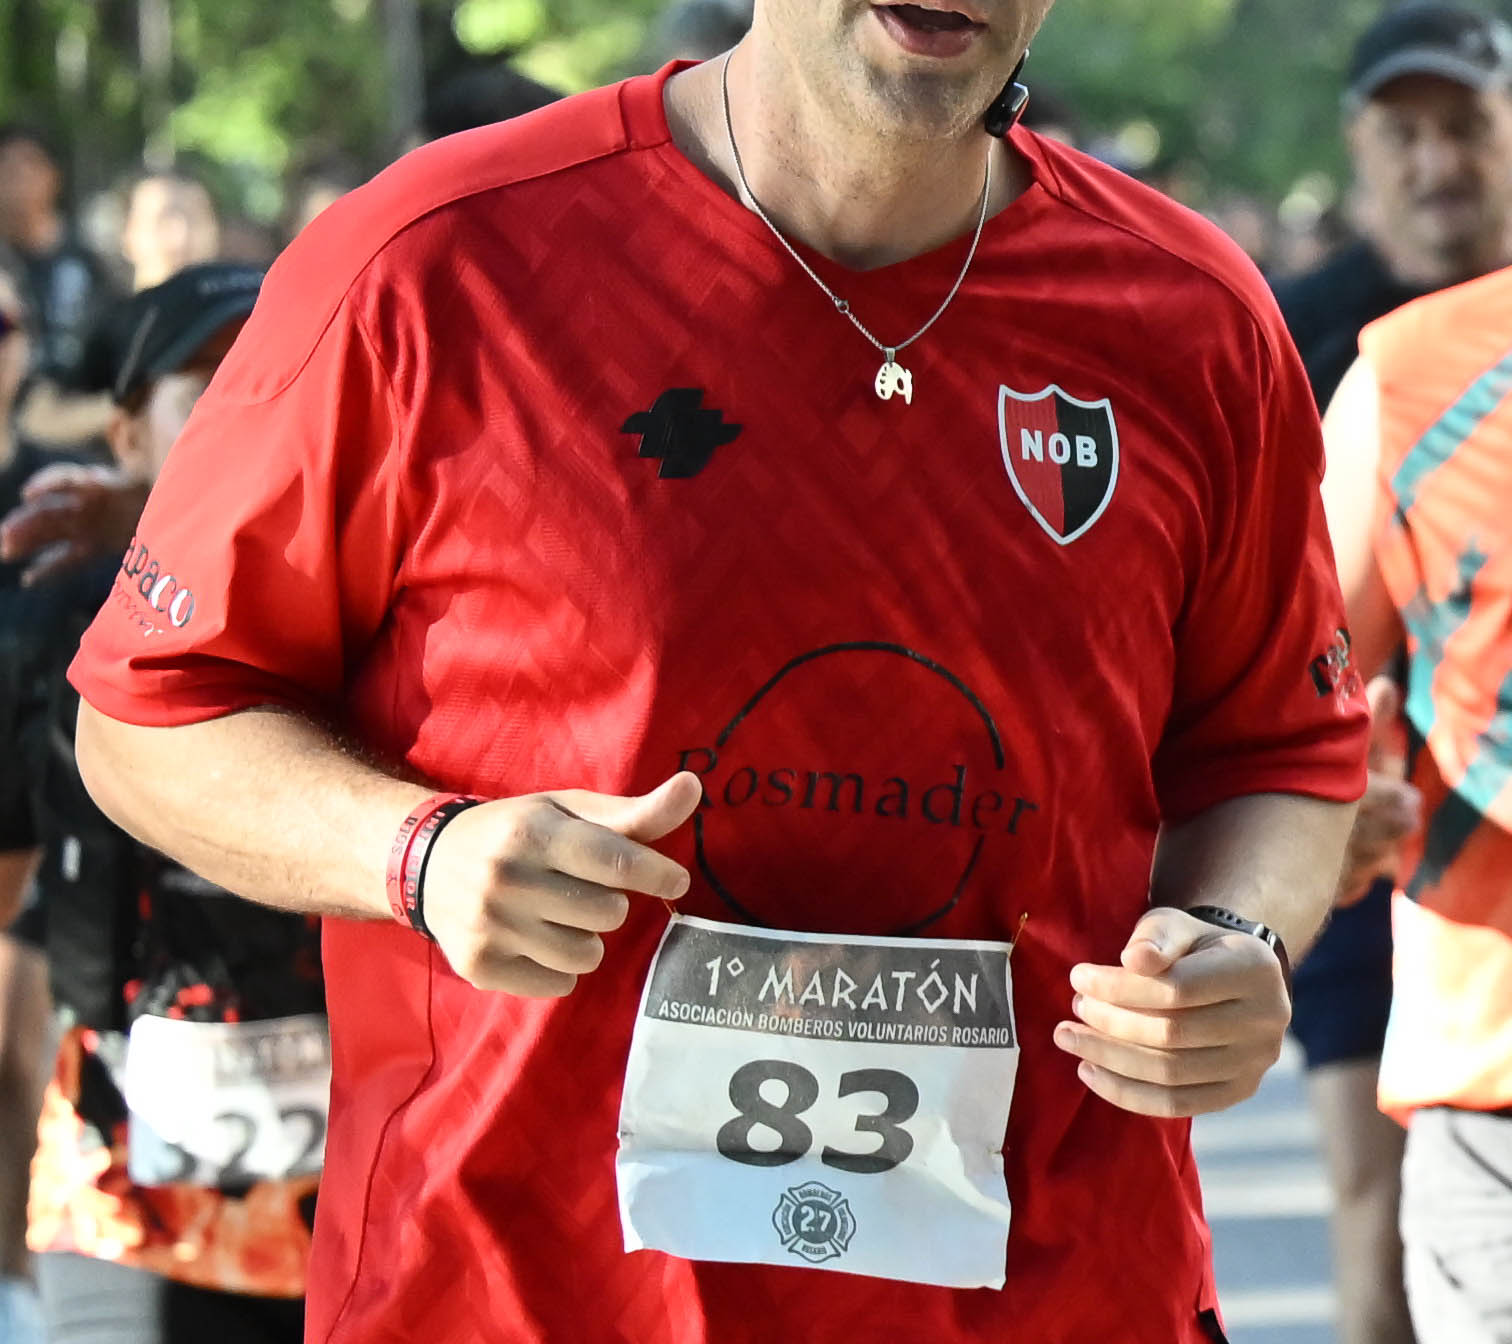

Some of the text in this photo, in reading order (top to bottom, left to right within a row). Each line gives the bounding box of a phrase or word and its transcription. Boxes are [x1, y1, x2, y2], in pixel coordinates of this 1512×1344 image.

[1020, 428, 1099, 468] NOB
[676, 746, 1039, 835] Rosmader
[758, 958, 979, 1015] MARATÓN
[658, 999, 1010, 1046] ASOCIACIÓN BOMBEROS VOLUNTARIOS ROSARIO
[715, 1058, 921, 1175] 83
[800, 1204, 832, 1233] 27
